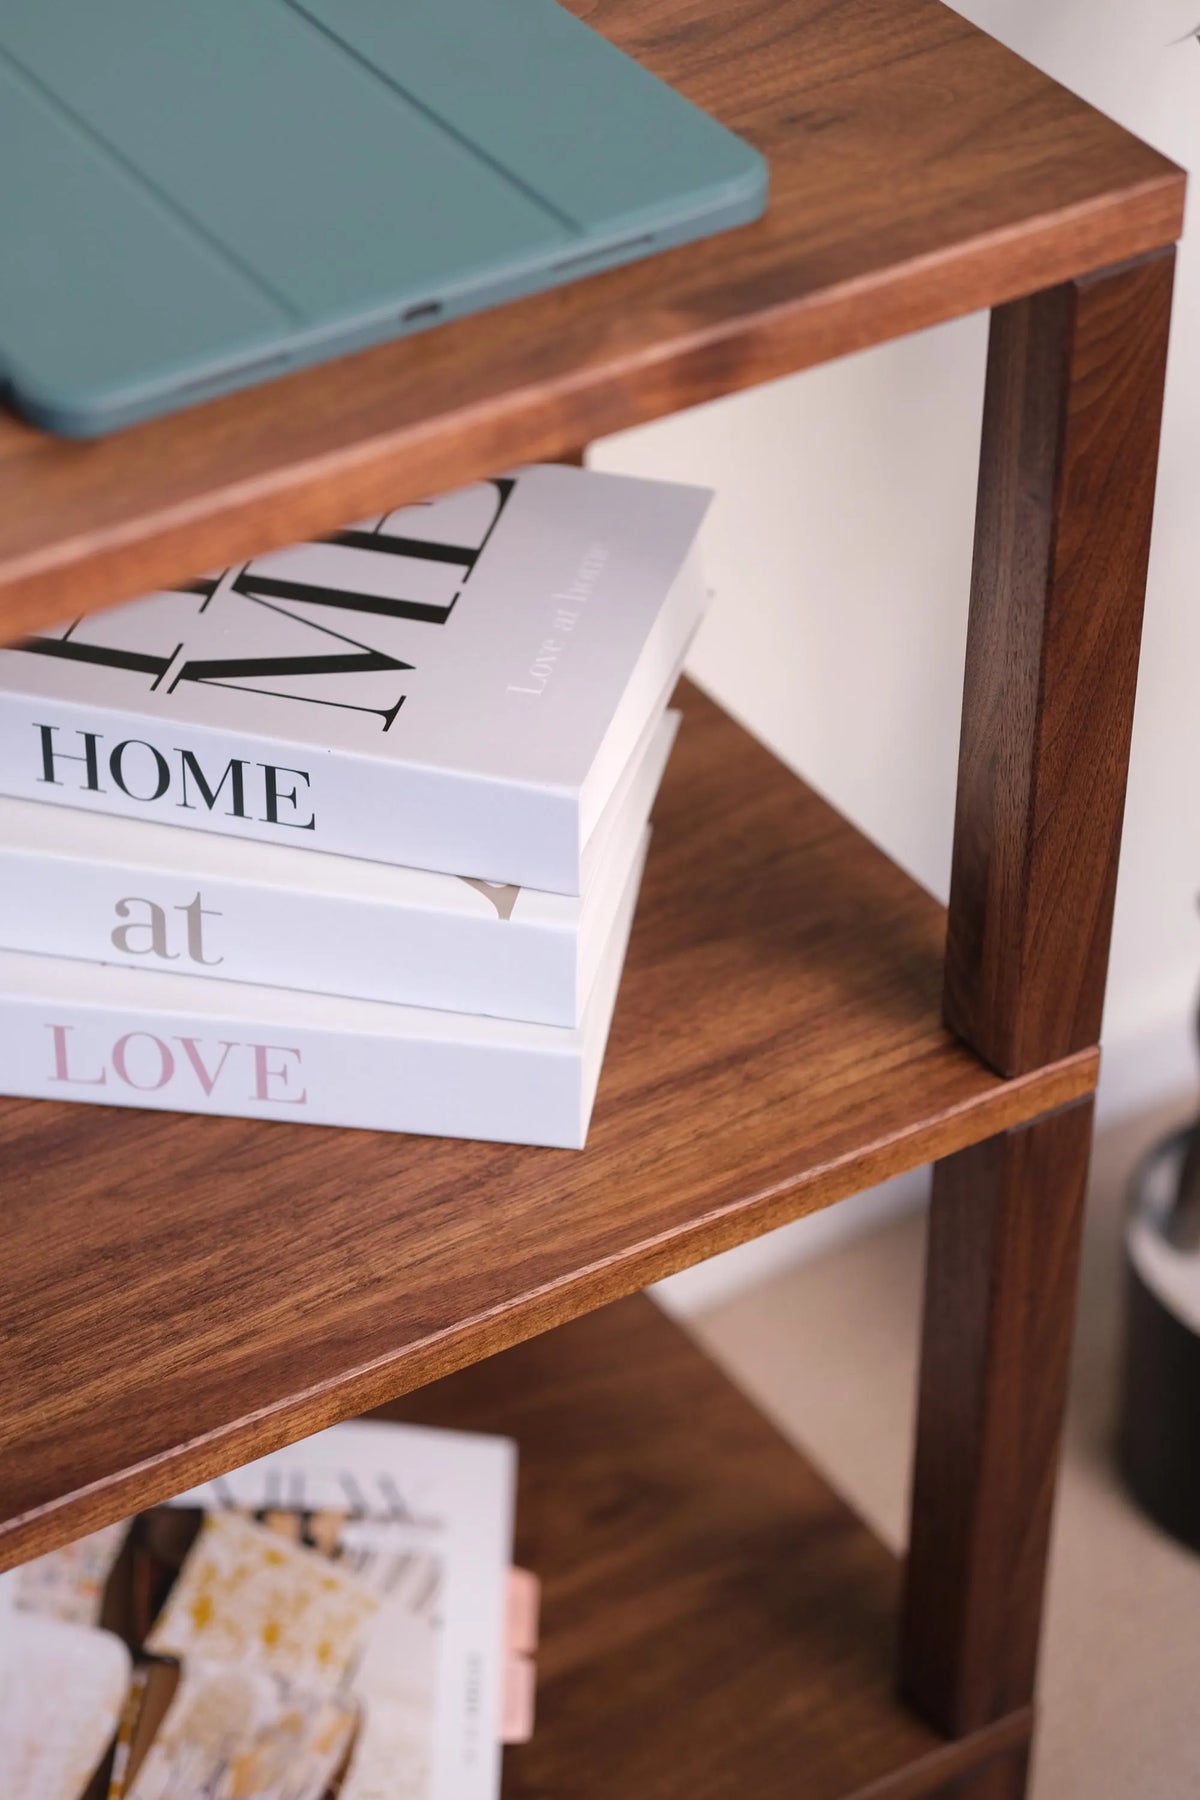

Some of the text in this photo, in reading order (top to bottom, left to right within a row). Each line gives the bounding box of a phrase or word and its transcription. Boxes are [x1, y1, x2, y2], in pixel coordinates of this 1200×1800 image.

[505, 542, 609, 697] Love at home
[32, 723, 316, 831] HOME
[110, 891, 224, 966] at
[43, 1024, 307, 1105] LOVE
